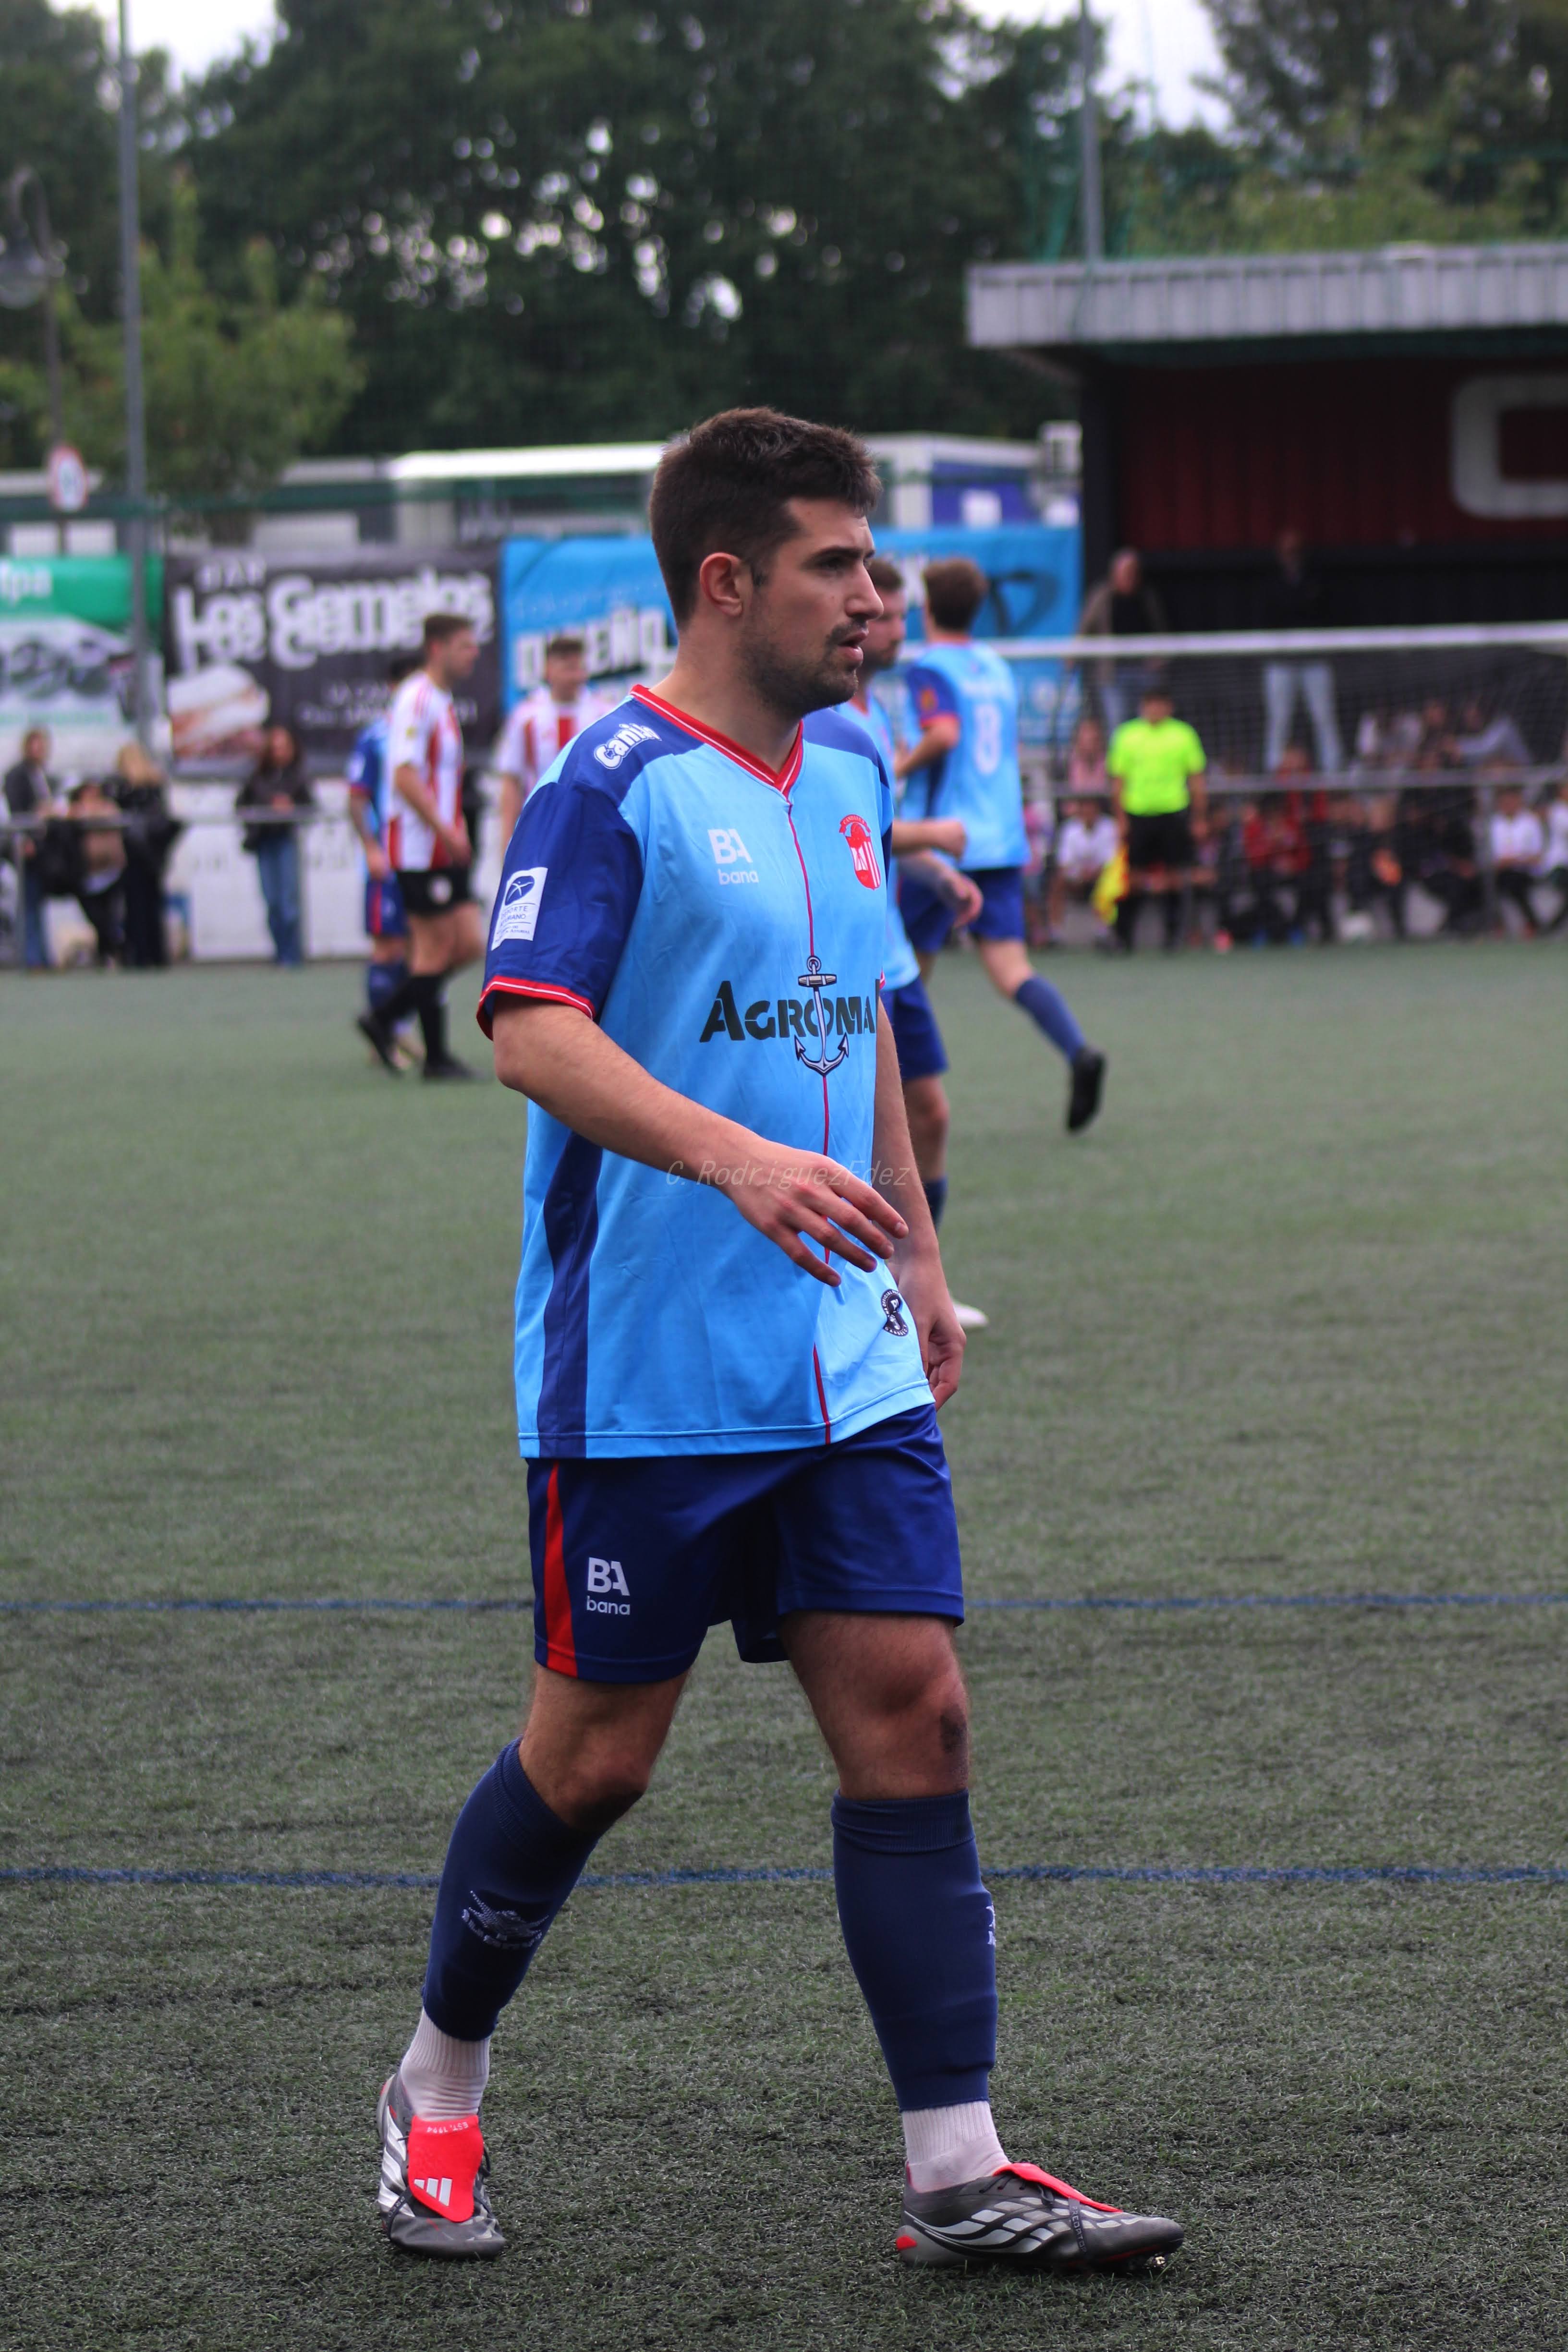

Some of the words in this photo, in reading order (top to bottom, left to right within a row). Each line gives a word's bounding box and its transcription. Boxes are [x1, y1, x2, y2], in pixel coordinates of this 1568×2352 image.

[268, 566, 495, 670] Gemelos
[717, 868, 759, 885] bana
[699, 979, 880, 1043] AGROMA
[586, 1595, 631, 1615] bana
[426, 2125, 448, 2134] 1994
[450, 2122, 469, 2131] EST.
